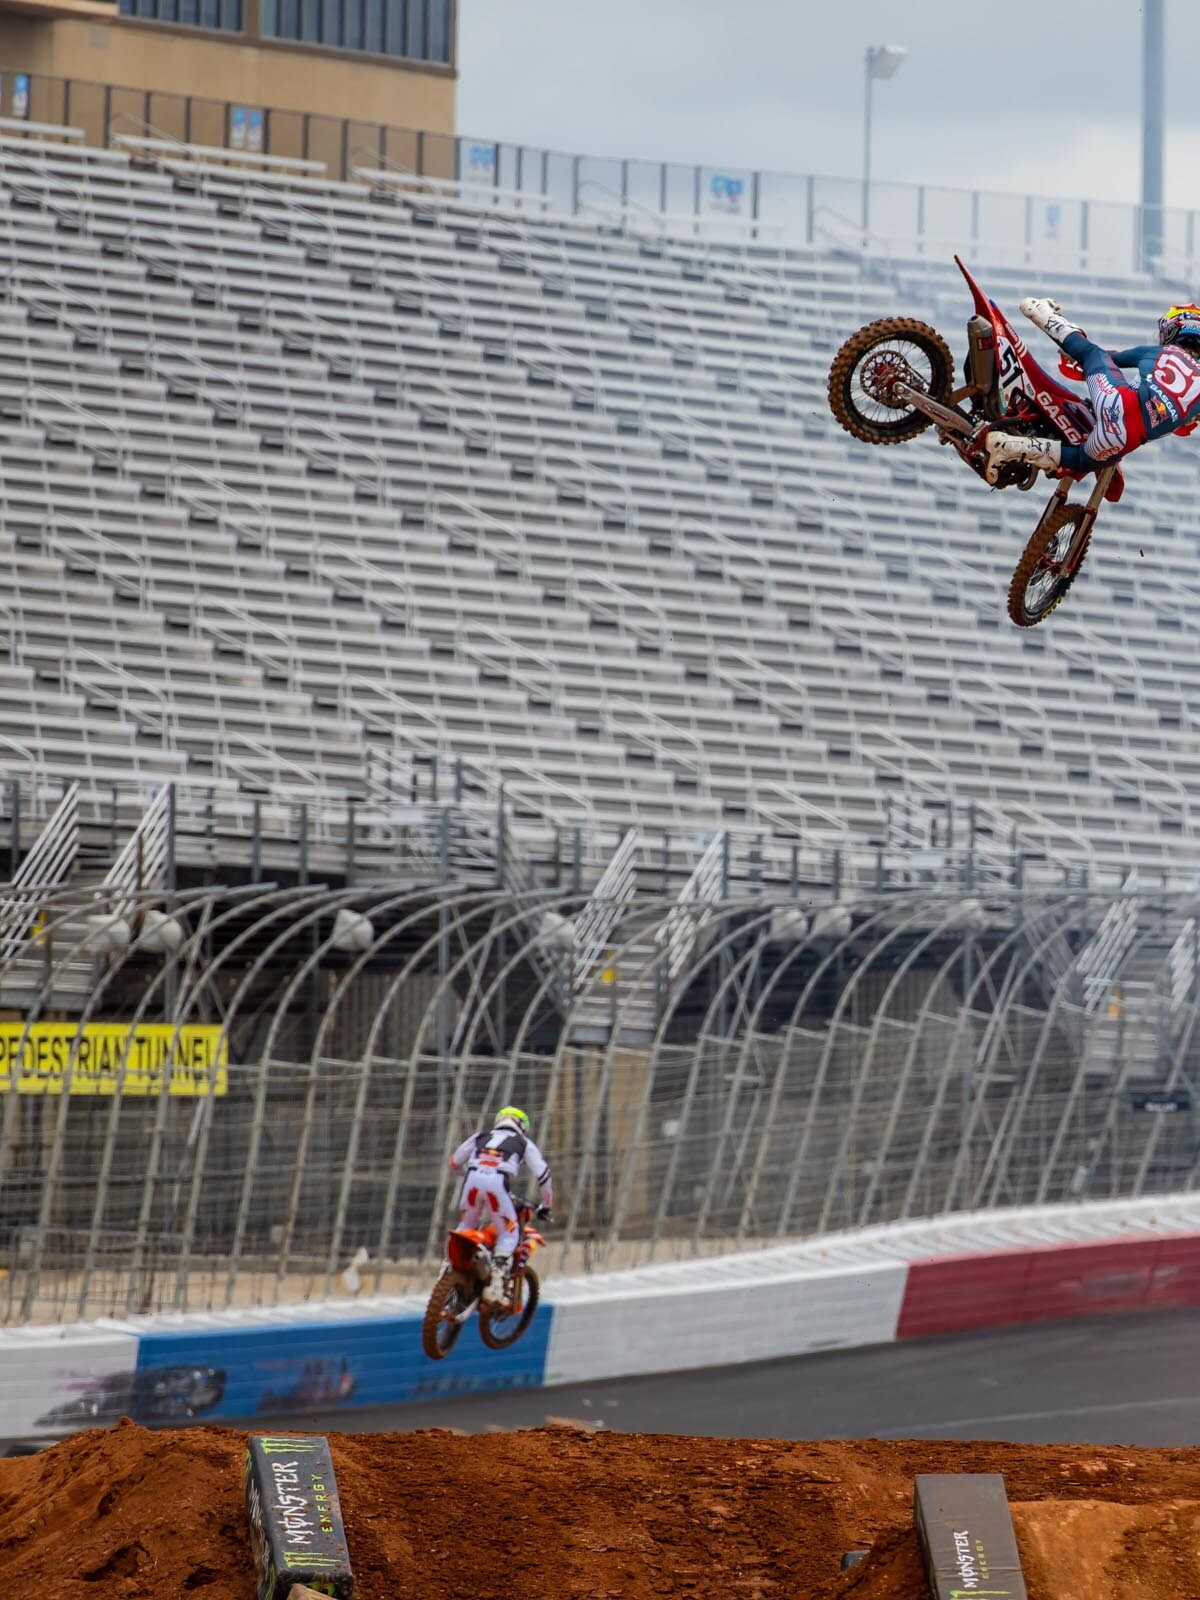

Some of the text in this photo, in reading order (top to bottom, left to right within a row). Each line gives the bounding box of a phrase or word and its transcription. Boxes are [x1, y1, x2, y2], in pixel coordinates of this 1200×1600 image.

[1000, 345, 1025, 389] 51
[1036, 391, 1084, 446] GASG
[1149, 383, 1179, 422] GASGAS
[272, 1460, 315, 1545] MONSTER
[311, 1473, 334, 1534] ENERGY
[953, 1530, 980, 1588] MONSTER
